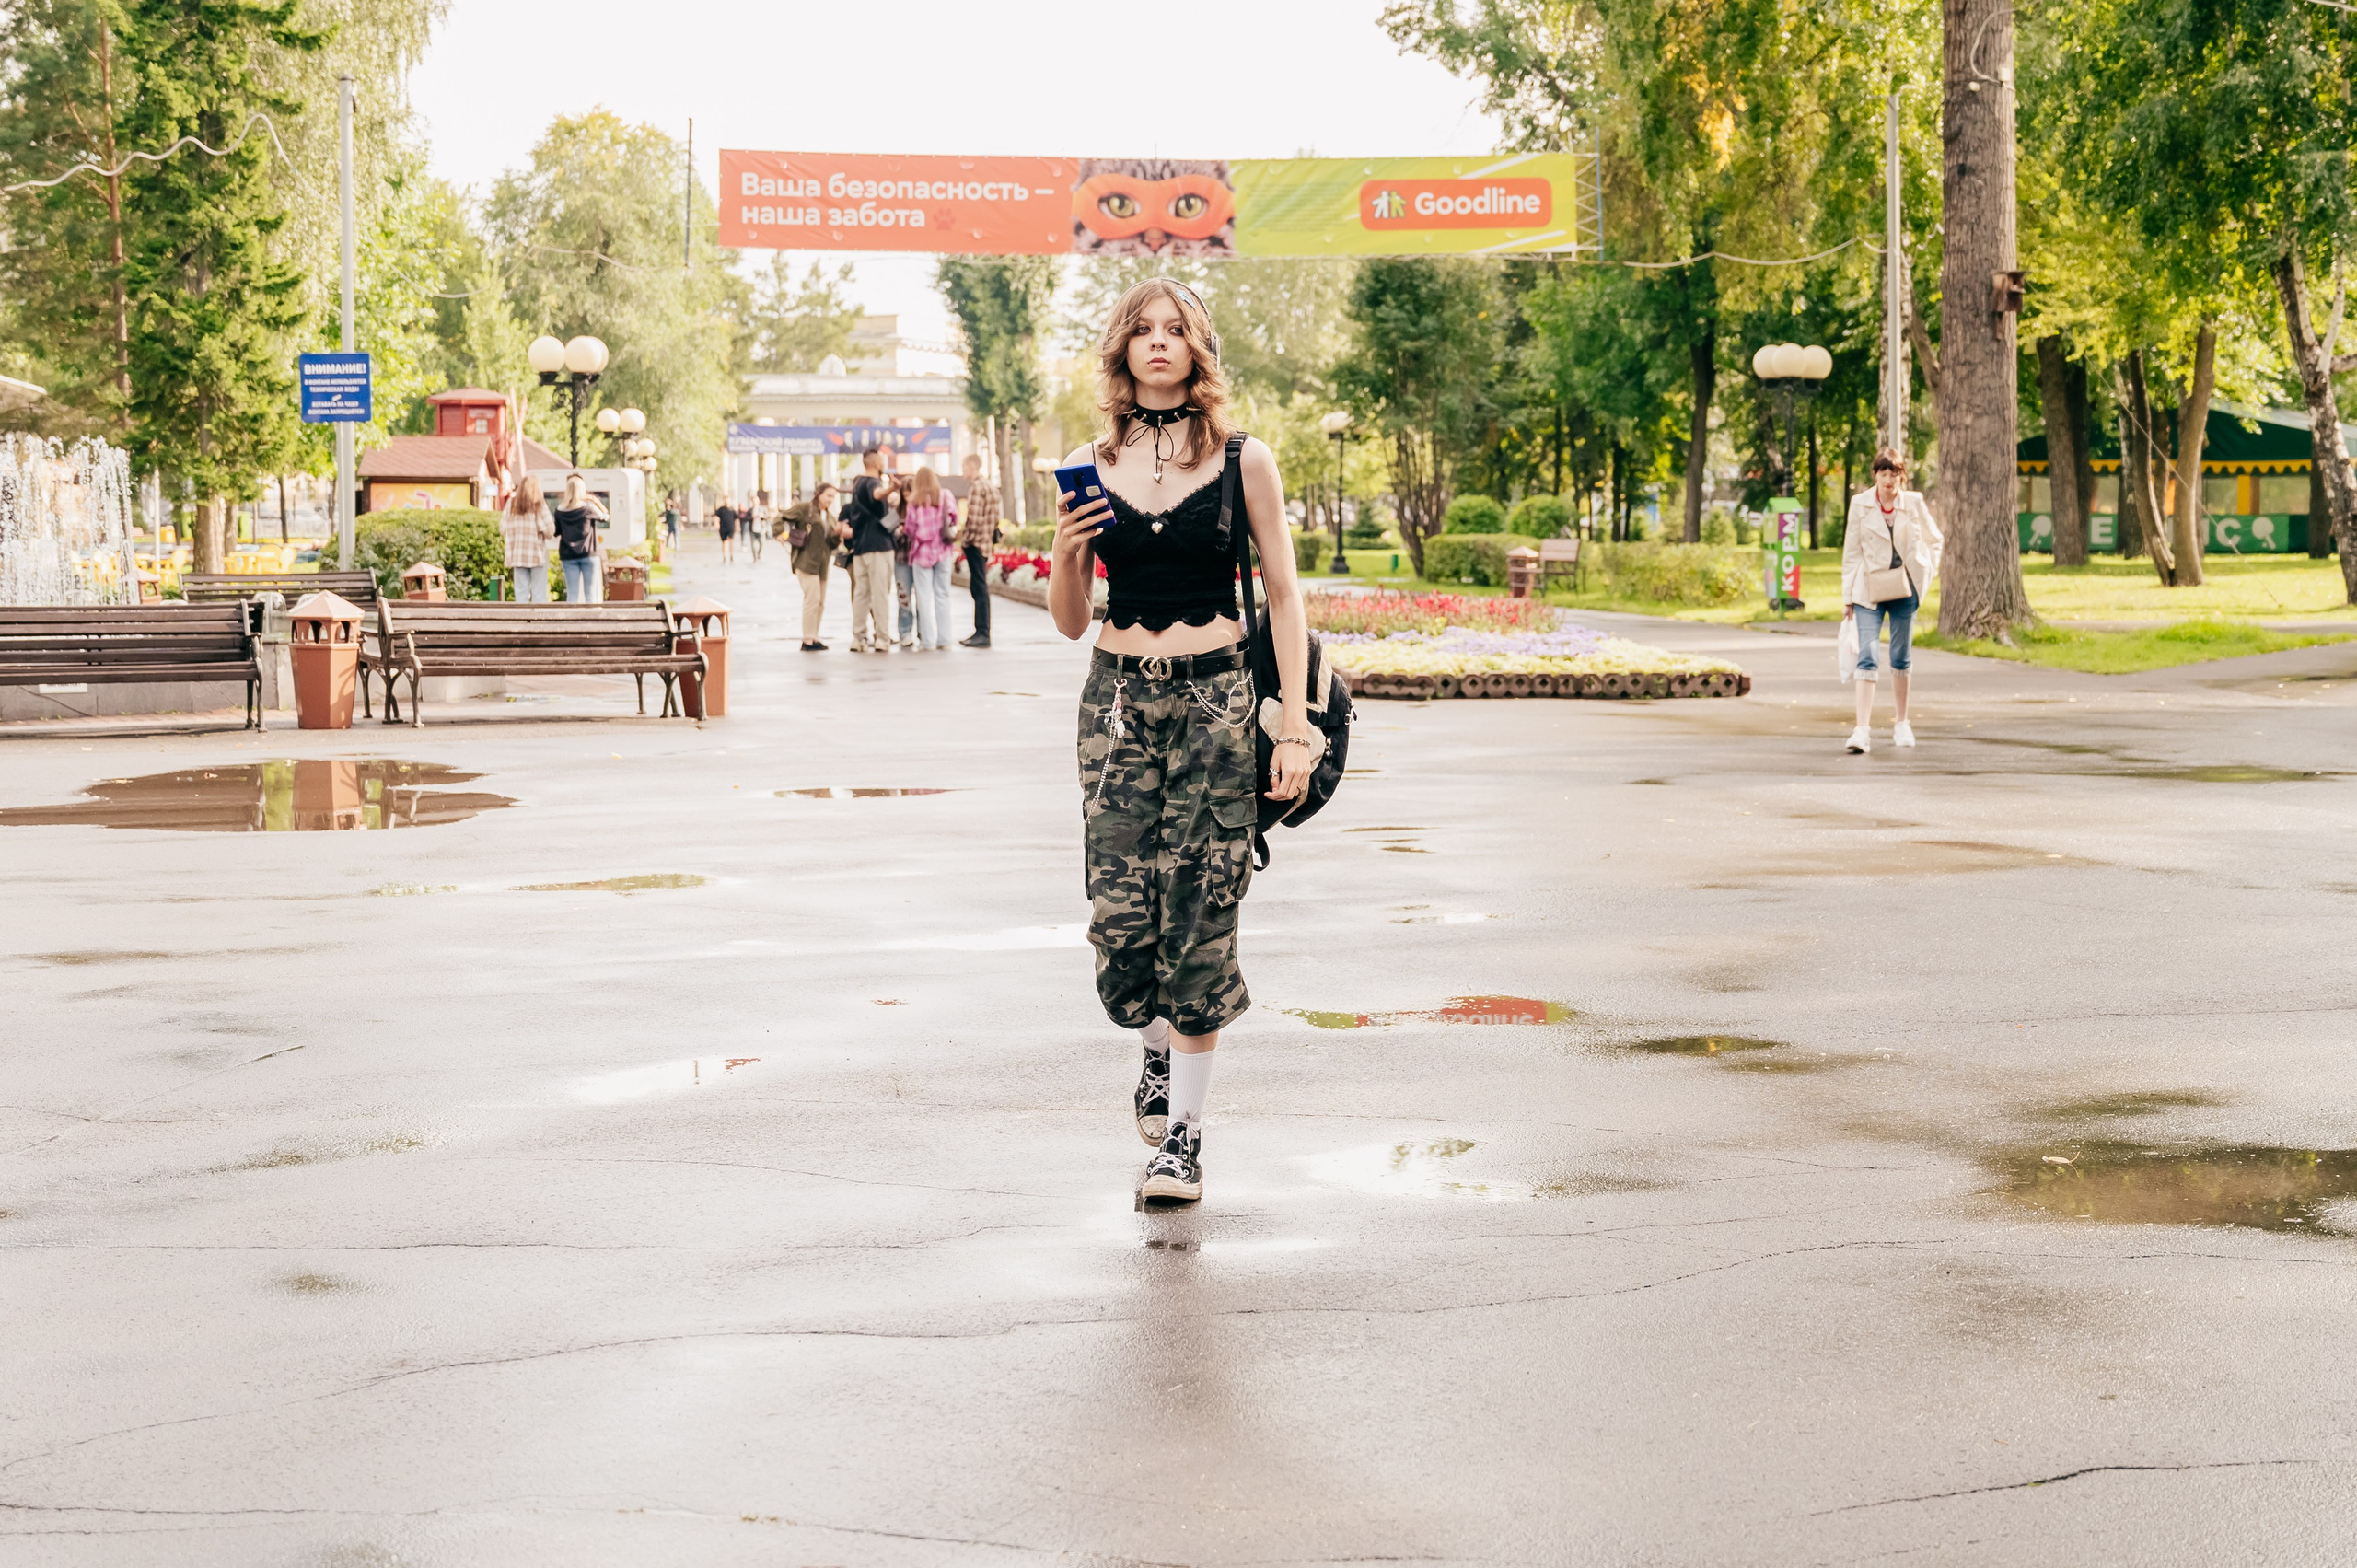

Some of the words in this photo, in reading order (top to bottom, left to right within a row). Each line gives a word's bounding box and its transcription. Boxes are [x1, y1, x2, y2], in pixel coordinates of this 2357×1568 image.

[741, 172, 820, 197] Ваша
[829, 172, 1029, 201] безопасность
[741, 204, 820, 226] наша
[828, 202, 925, 227] забота
[1415, 187, 1541, 215] Goodline
[304, 363, 366, 375] ВНИМАНИЕ!
[1782, 513, 1795, 591] КОРМ
